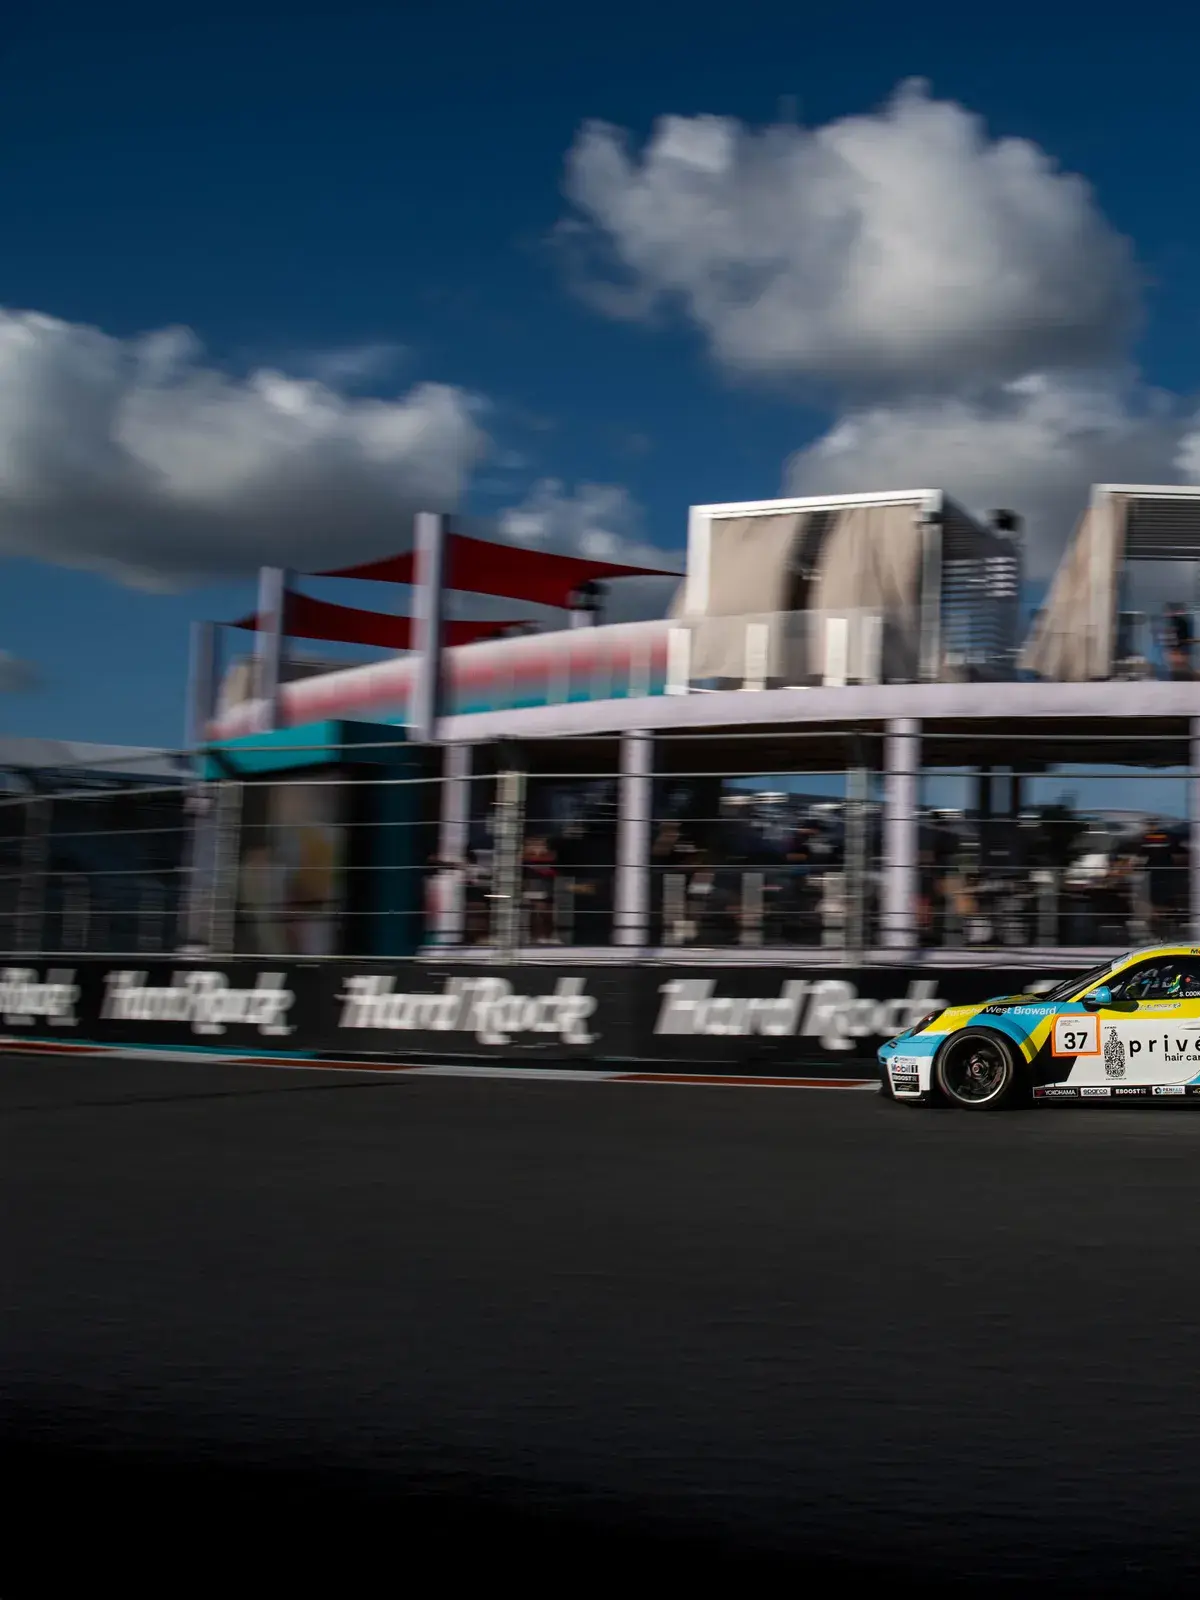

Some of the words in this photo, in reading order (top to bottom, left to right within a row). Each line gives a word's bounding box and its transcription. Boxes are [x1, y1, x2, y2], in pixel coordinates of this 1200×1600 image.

[334, 975, 474, 1030] Hard
[459, 977, 598, 1045] Rock
[653, 979, 811, 1035] Hard
[985, 1005, 1011, 1014] West
[1013, 1005, 1057, 1015] Broward
[1064, 1032, 1088, 1050] 37
[1165, 1052, 1184, 1061] hair
[891, 1063, 911, 1073] Mobil
